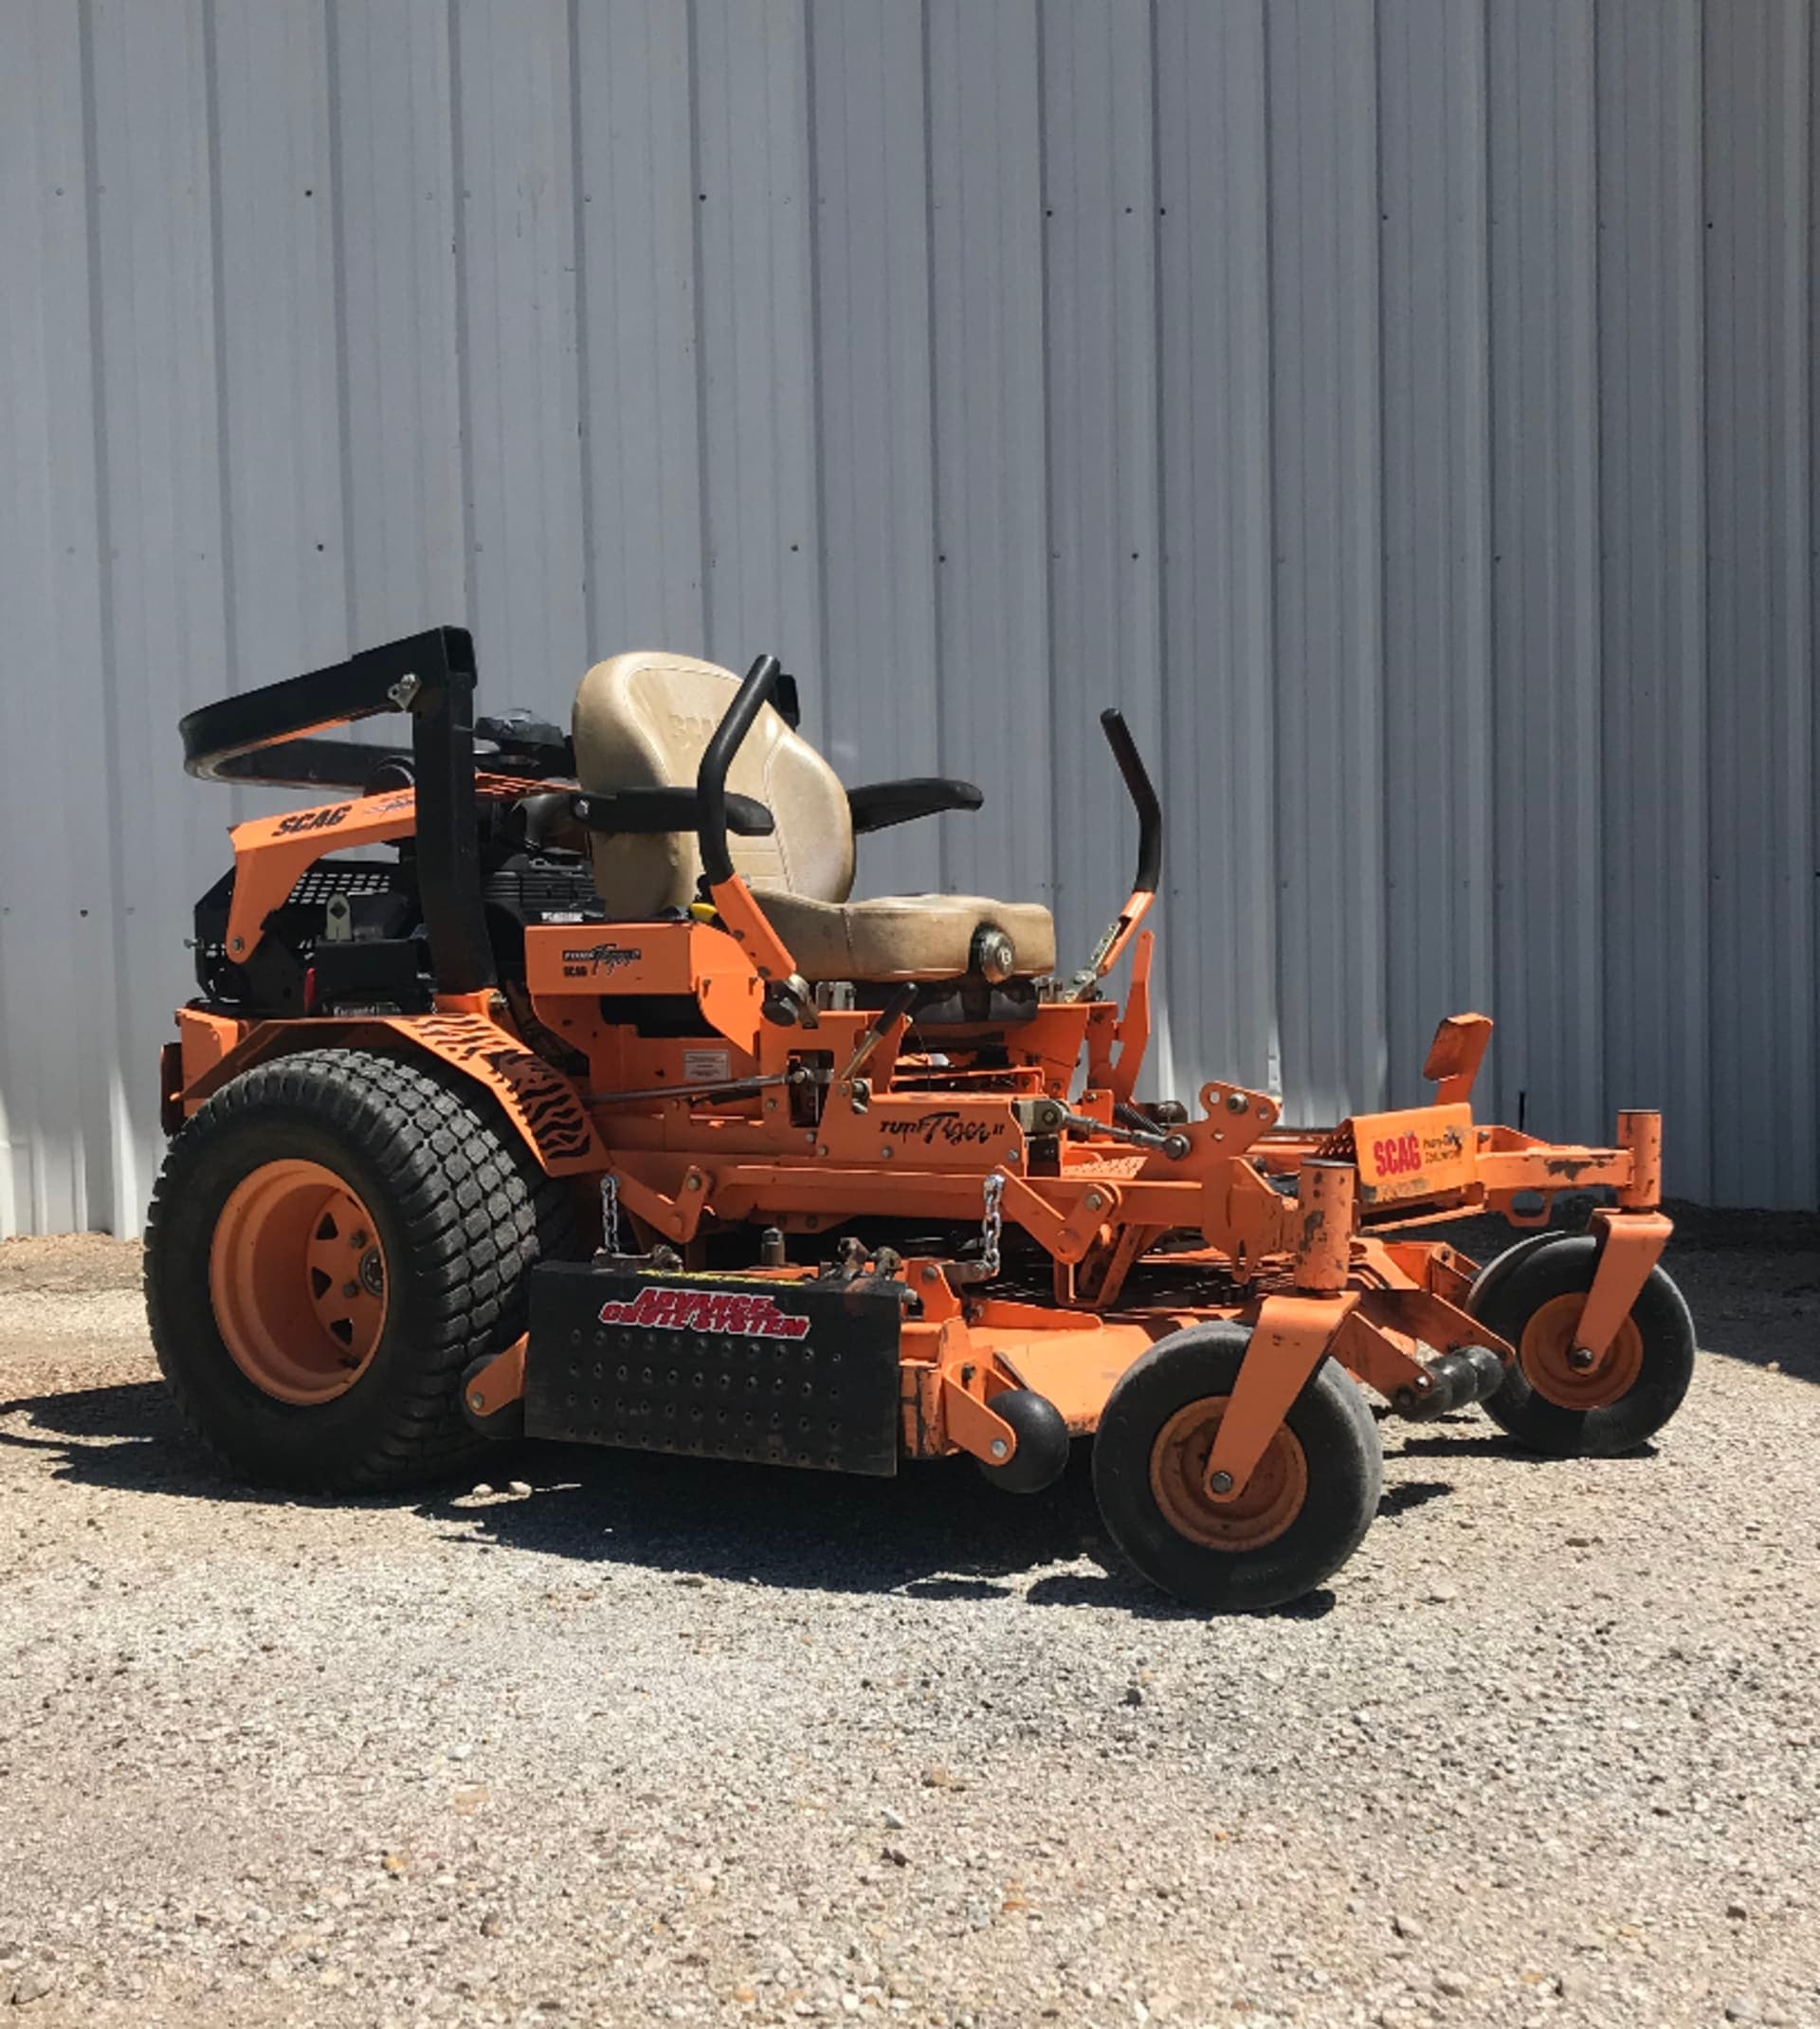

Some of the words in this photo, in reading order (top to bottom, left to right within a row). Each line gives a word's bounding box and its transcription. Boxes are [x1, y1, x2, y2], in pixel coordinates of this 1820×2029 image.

[271, 805, 353, 836] SCAG
[920, 1111, 992, 1145] Tiger
[1374, 1134, 1421, 1176] SCAG
[693, 1309, 810, 1337] SYSTEM
